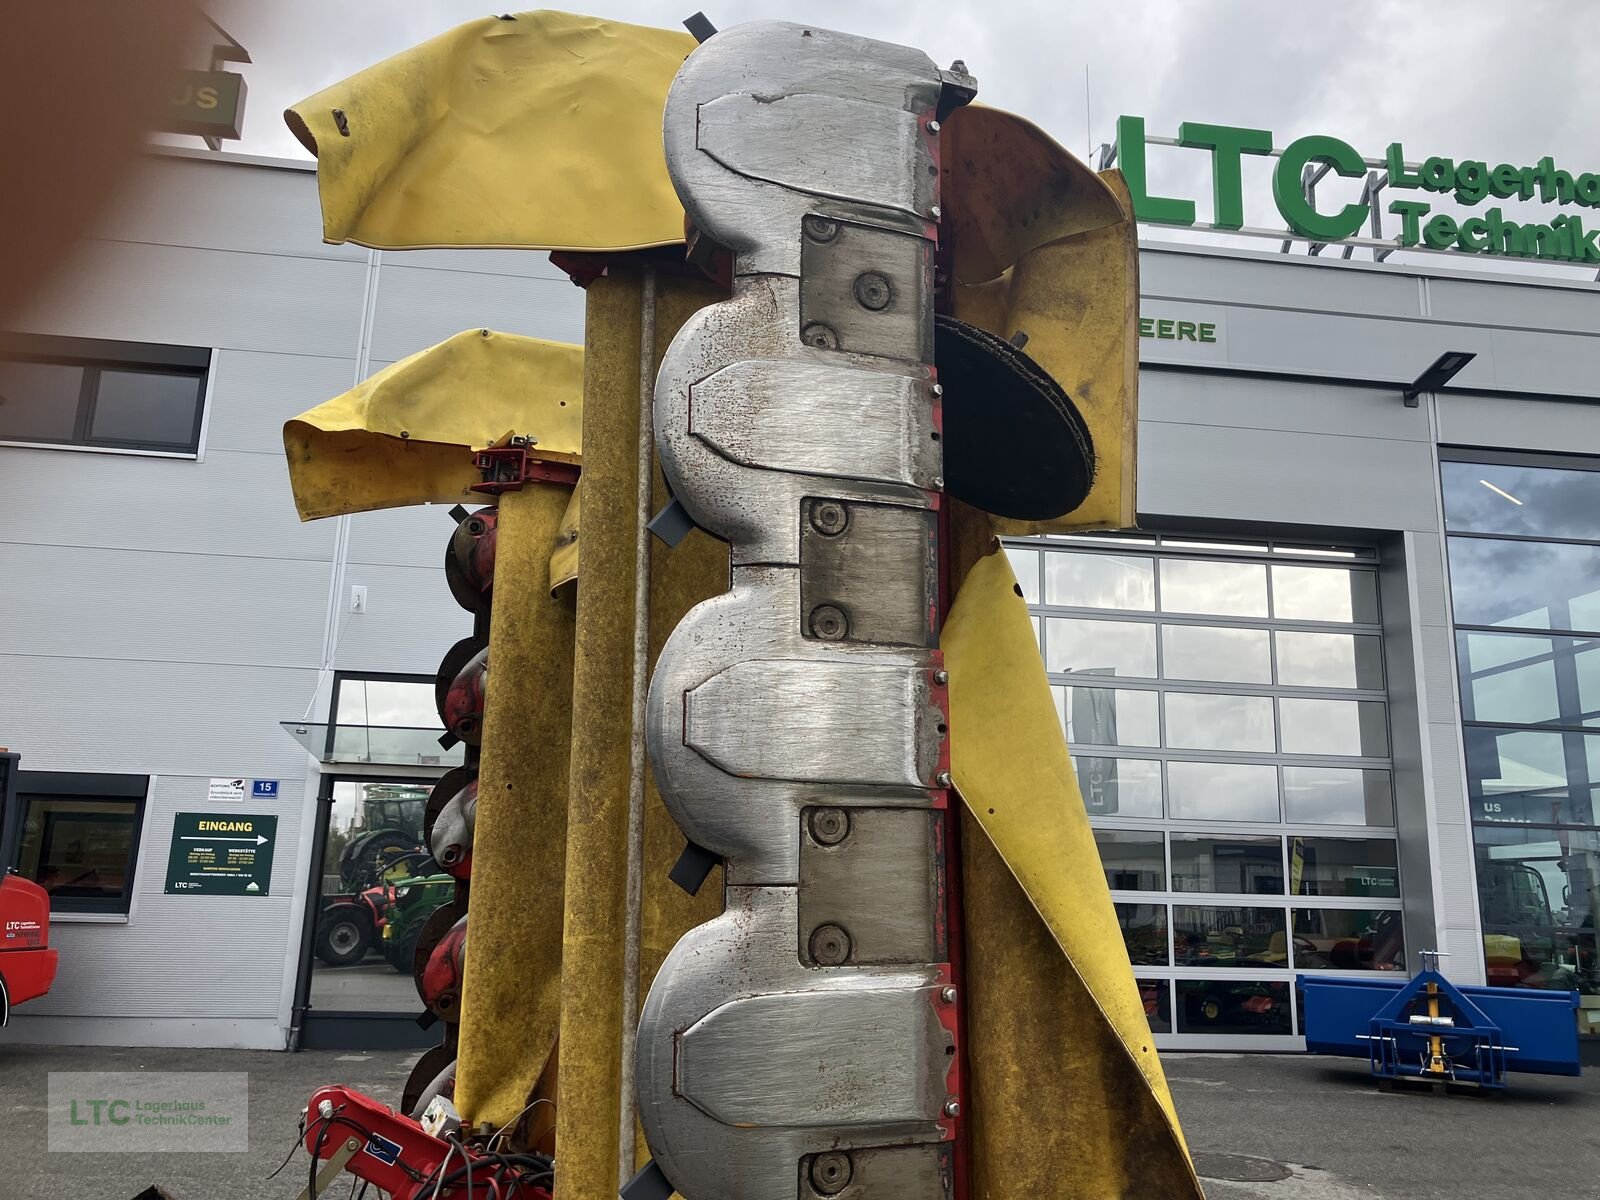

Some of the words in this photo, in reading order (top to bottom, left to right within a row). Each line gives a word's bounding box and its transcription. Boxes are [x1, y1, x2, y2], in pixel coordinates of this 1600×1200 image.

[1116, 115, 1370, 241] LTC
[1138, 317, 1217, 343] EERE
[259, 782, 272, 792] 15
[198, 821, 253, 832] EINGANG
[174, 881, 188, 889] LTC
[6, 921, 20, 930] LTC
